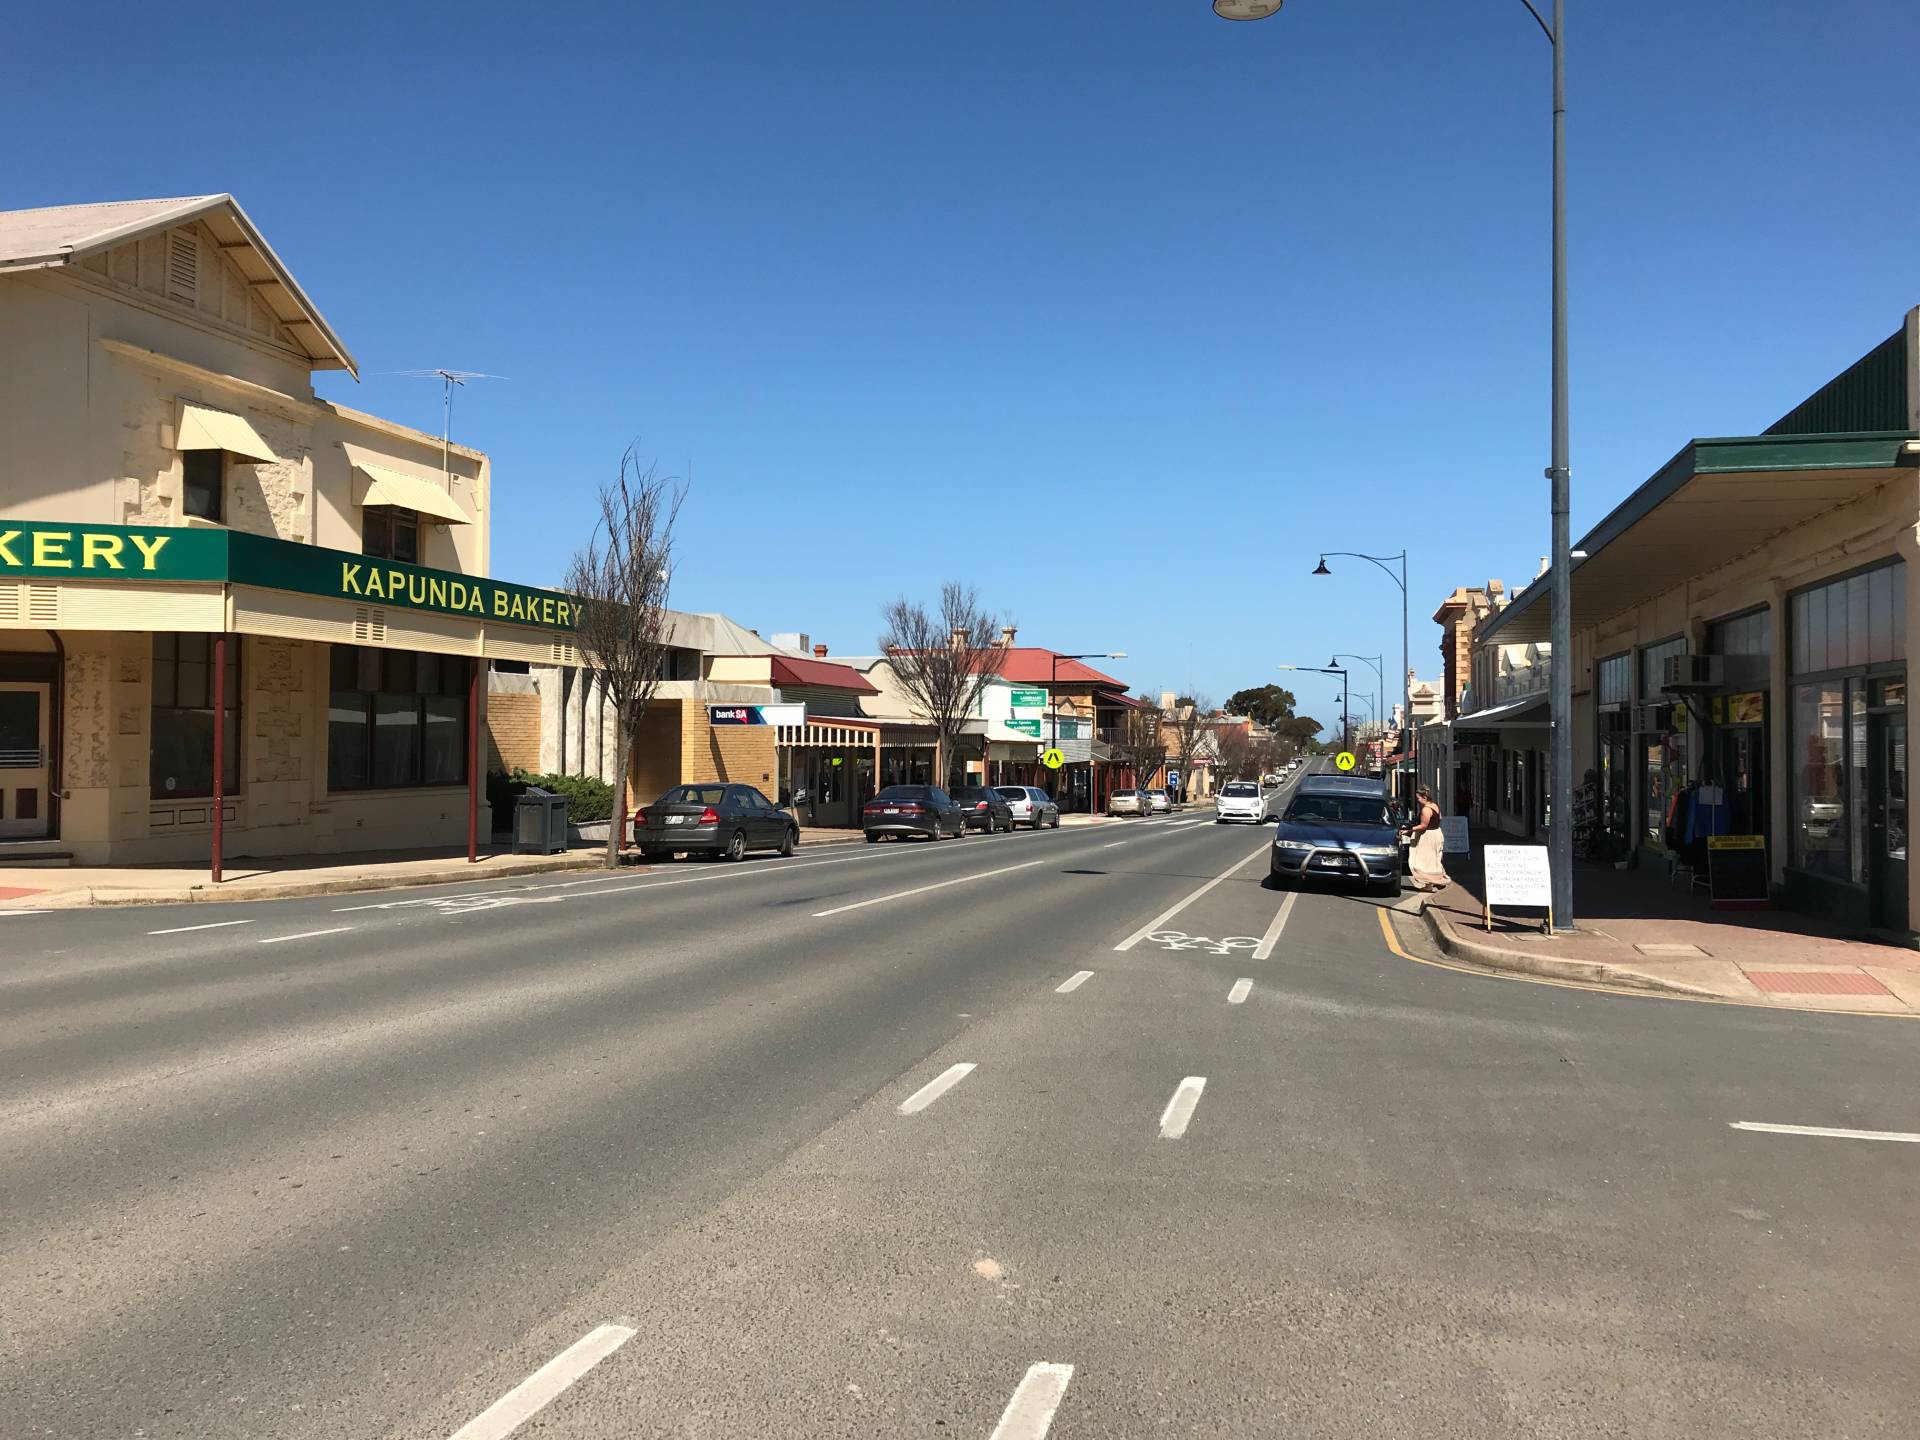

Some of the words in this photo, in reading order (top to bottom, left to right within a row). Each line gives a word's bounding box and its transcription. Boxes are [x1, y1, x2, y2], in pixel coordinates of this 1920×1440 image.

[341, 561, 485, 614] KAPUNDA
[493, 589, 583, 628] BAKERY
[716, 709, 747, 719] bankSA
